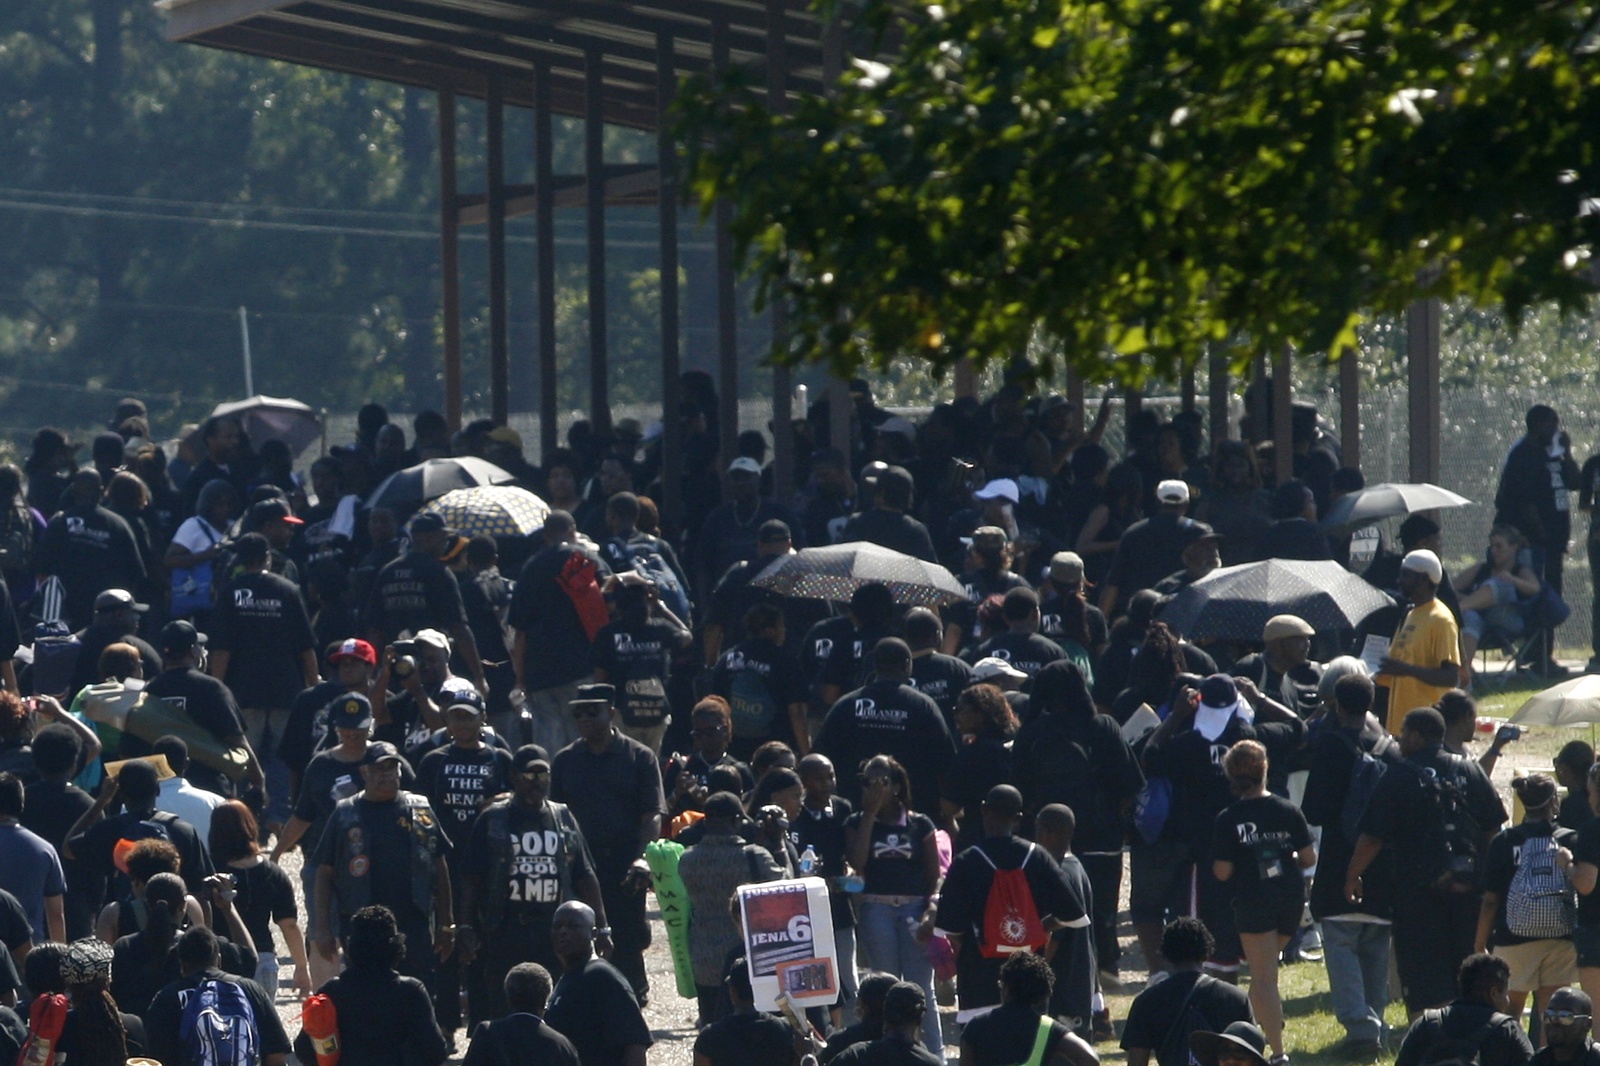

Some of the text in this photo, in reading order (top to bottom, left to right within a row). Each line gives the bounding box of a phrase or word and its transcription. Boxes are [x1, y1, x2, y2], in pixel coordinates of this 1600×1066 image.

[444, 764, 490, 776] FREE
[448, 777, 484, 790] THE
[509, 879, 523, 901] 2
[745, 884, 806, 899] JUSTICE
[751, 914, 813, 947] JENA 6
